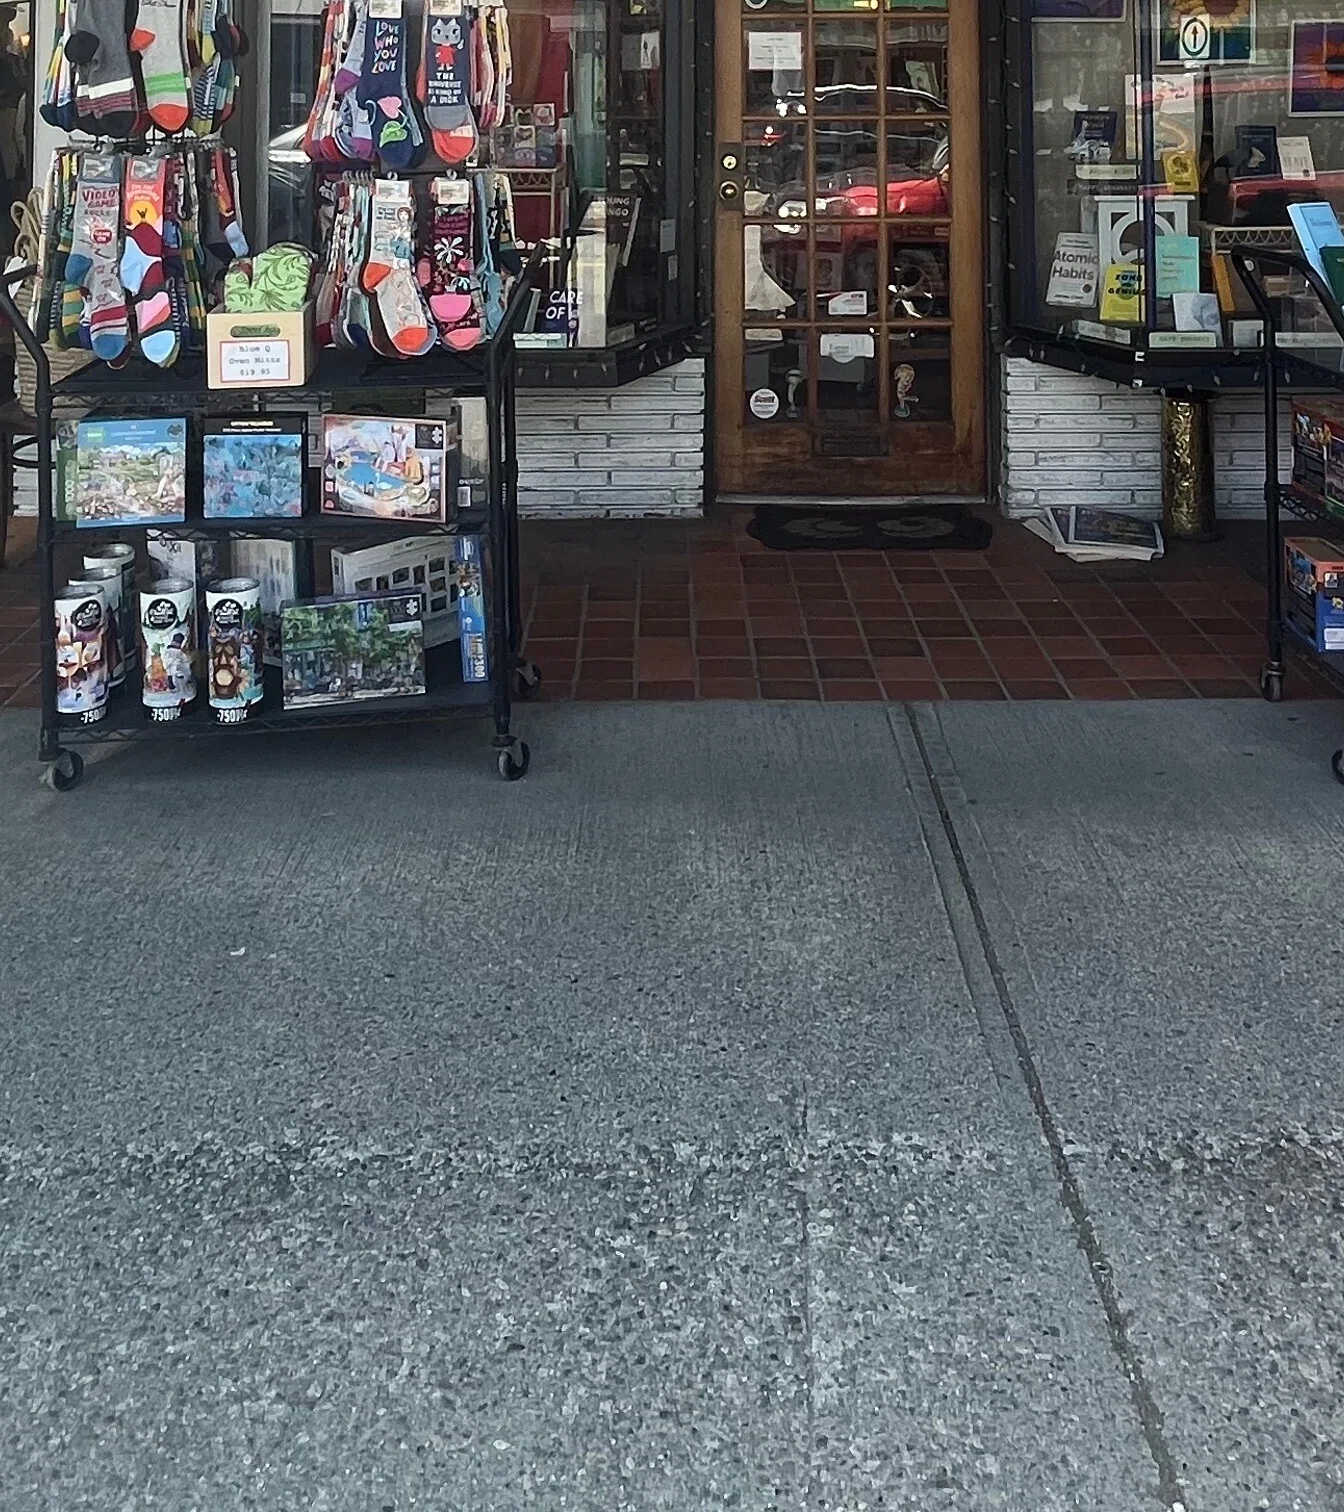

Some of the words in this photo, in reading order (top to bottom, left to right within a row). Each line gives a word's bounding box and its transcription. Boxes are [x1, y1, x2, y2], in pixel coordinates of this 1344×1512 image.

[373, 48, 398, 63] YOU
[1054, 250, 1099, 265] Atomic
[1052, 266, 1095, 281] Habits
[550, 290, 584, 305] CARE
[545, 306, 567, 320] OF
